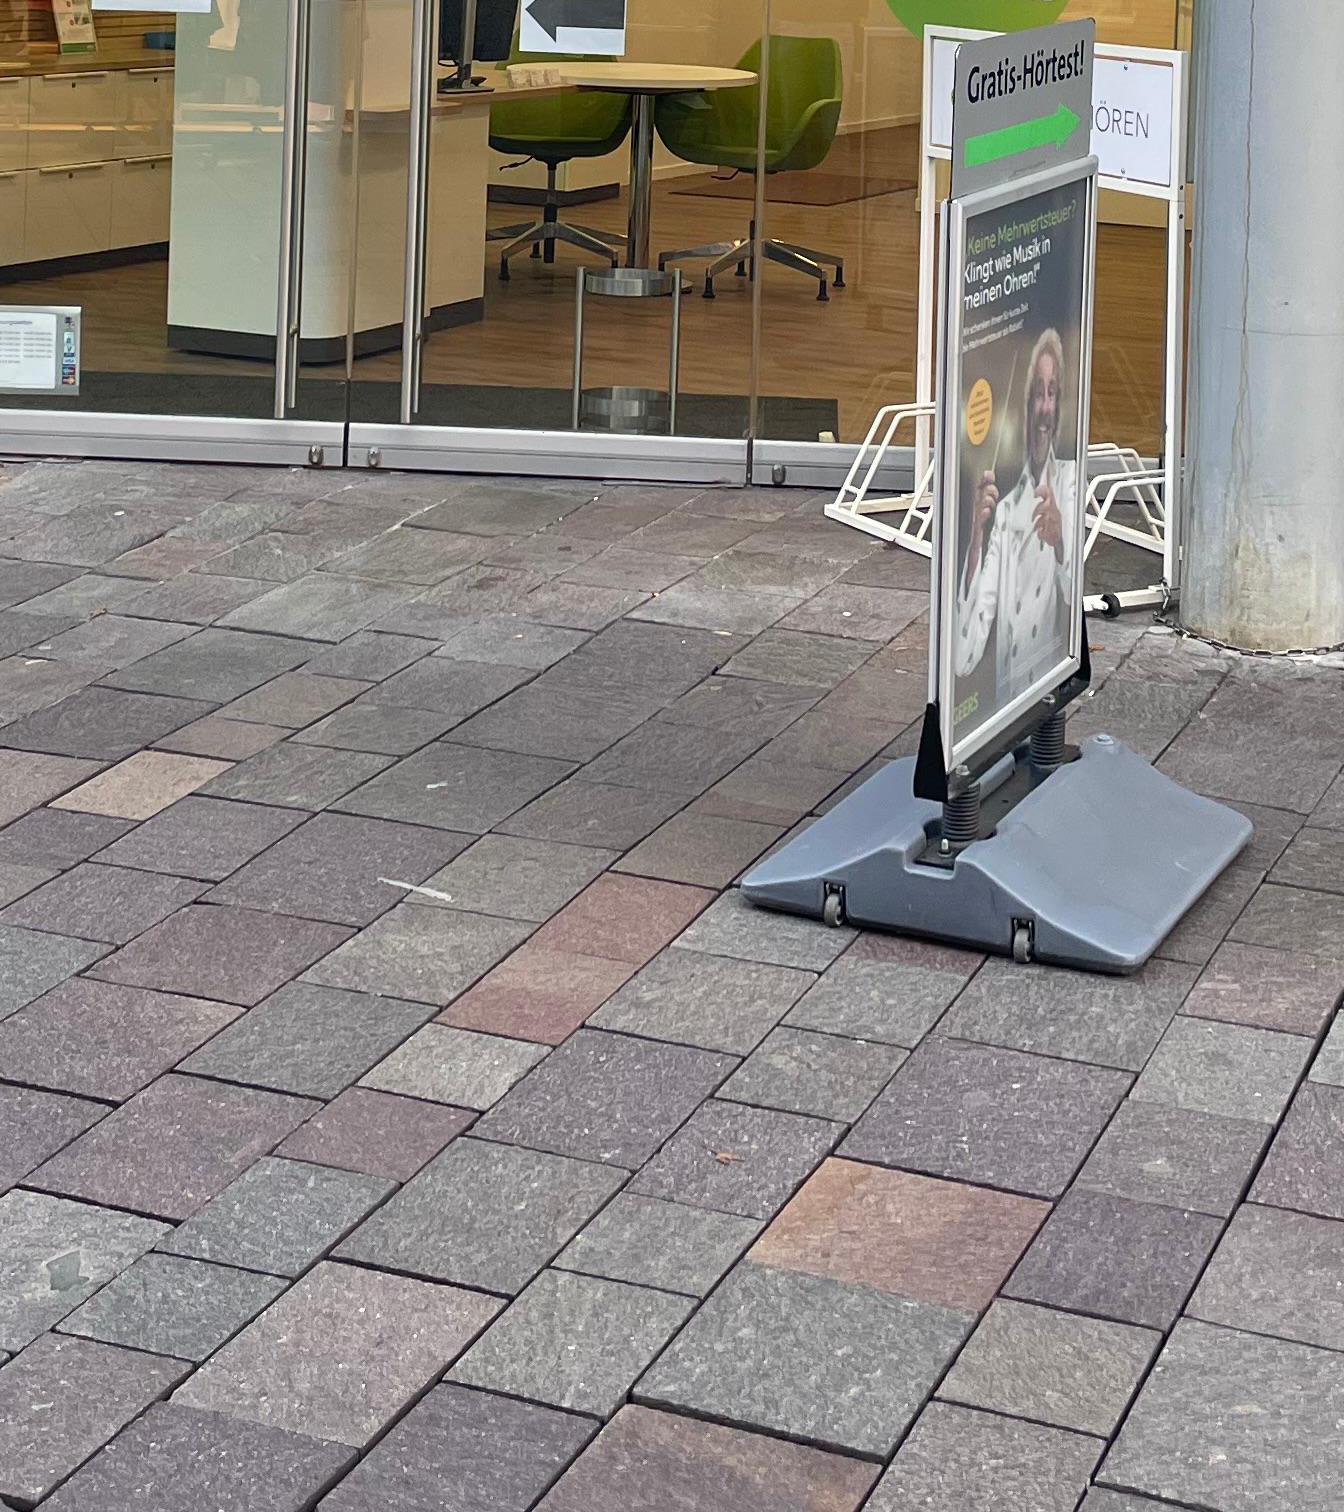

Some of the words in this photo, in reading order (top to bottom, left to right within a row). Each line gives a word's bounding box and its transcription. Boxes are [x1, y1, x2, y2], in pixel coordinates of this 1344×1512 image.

[967, 39, 1086, 105] Gratis-Hörtest!
[1093, 99, 1150, 139] ÖREN
[967, 231, 997, 257] Keine
[997, 199, 1077, 246] Mehrwertsteuer?
[994, 250, 1012, 273] wie
[1012, 237, 1041, 266] Musik
[1041, 234, 1052, 256] in
